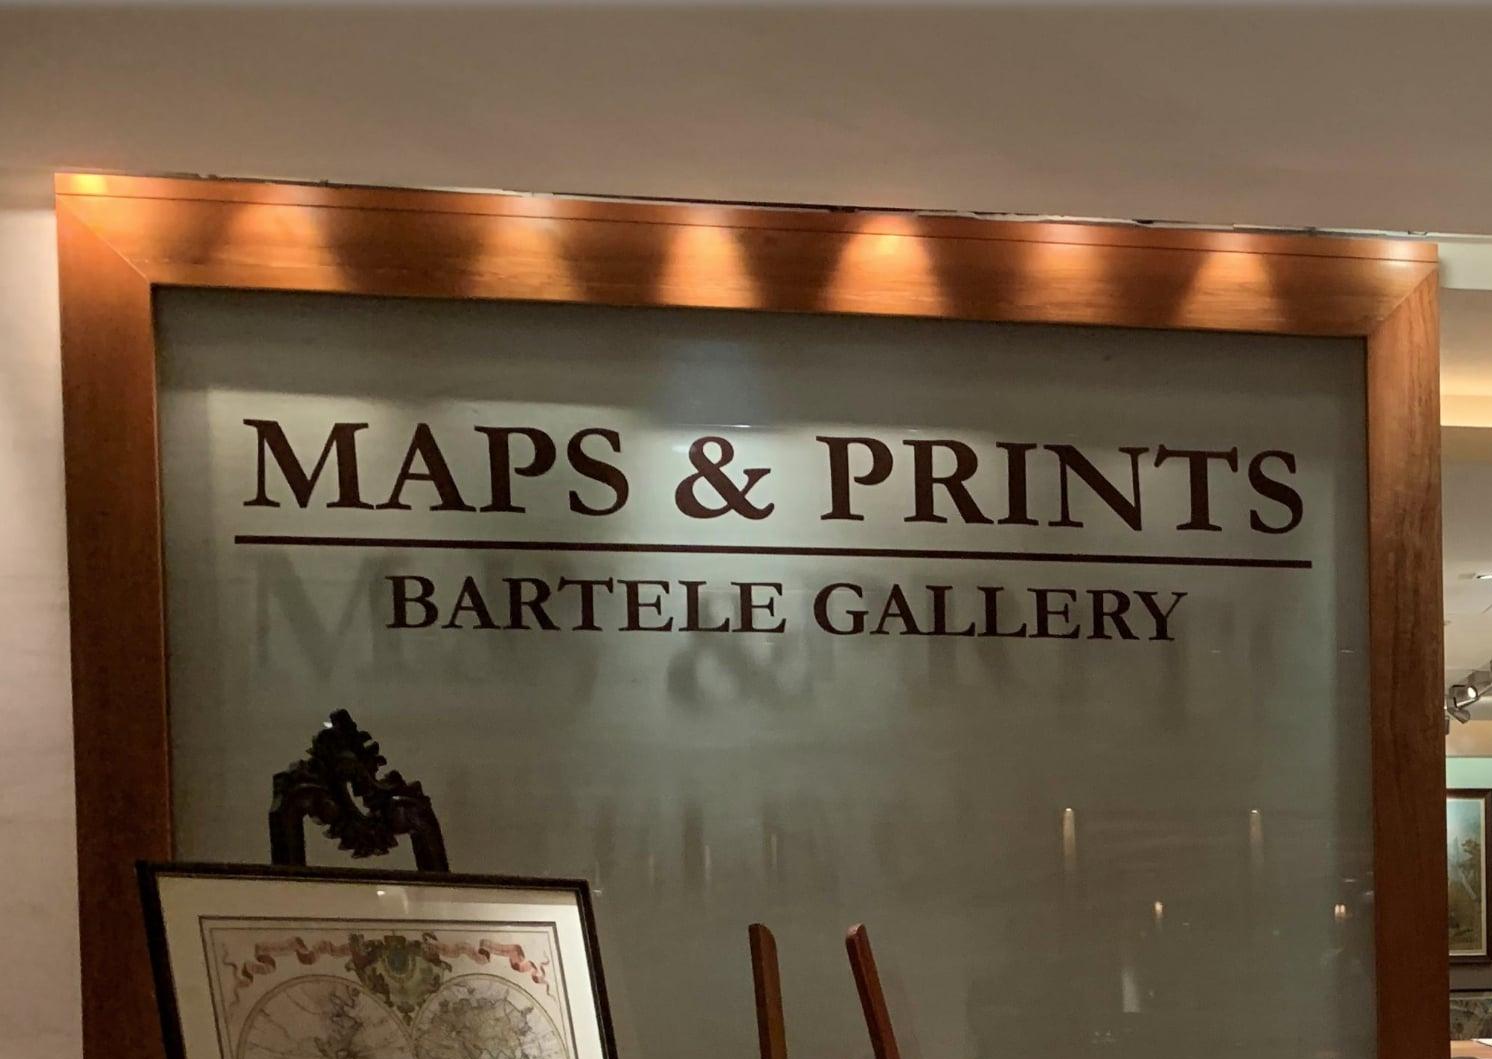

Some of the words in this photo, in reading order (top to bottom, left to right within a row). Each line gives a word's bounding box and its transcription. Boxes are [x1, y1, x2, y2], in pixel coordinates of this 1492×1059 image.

[243, 419, 629, 516] MAPS
[675, 436, 775, 520] &
[816, 436, 1304, 535] PRINTS
[384, 575, 787, 634] BARTELE
[813, 582, 1188, 644] GALLERY
